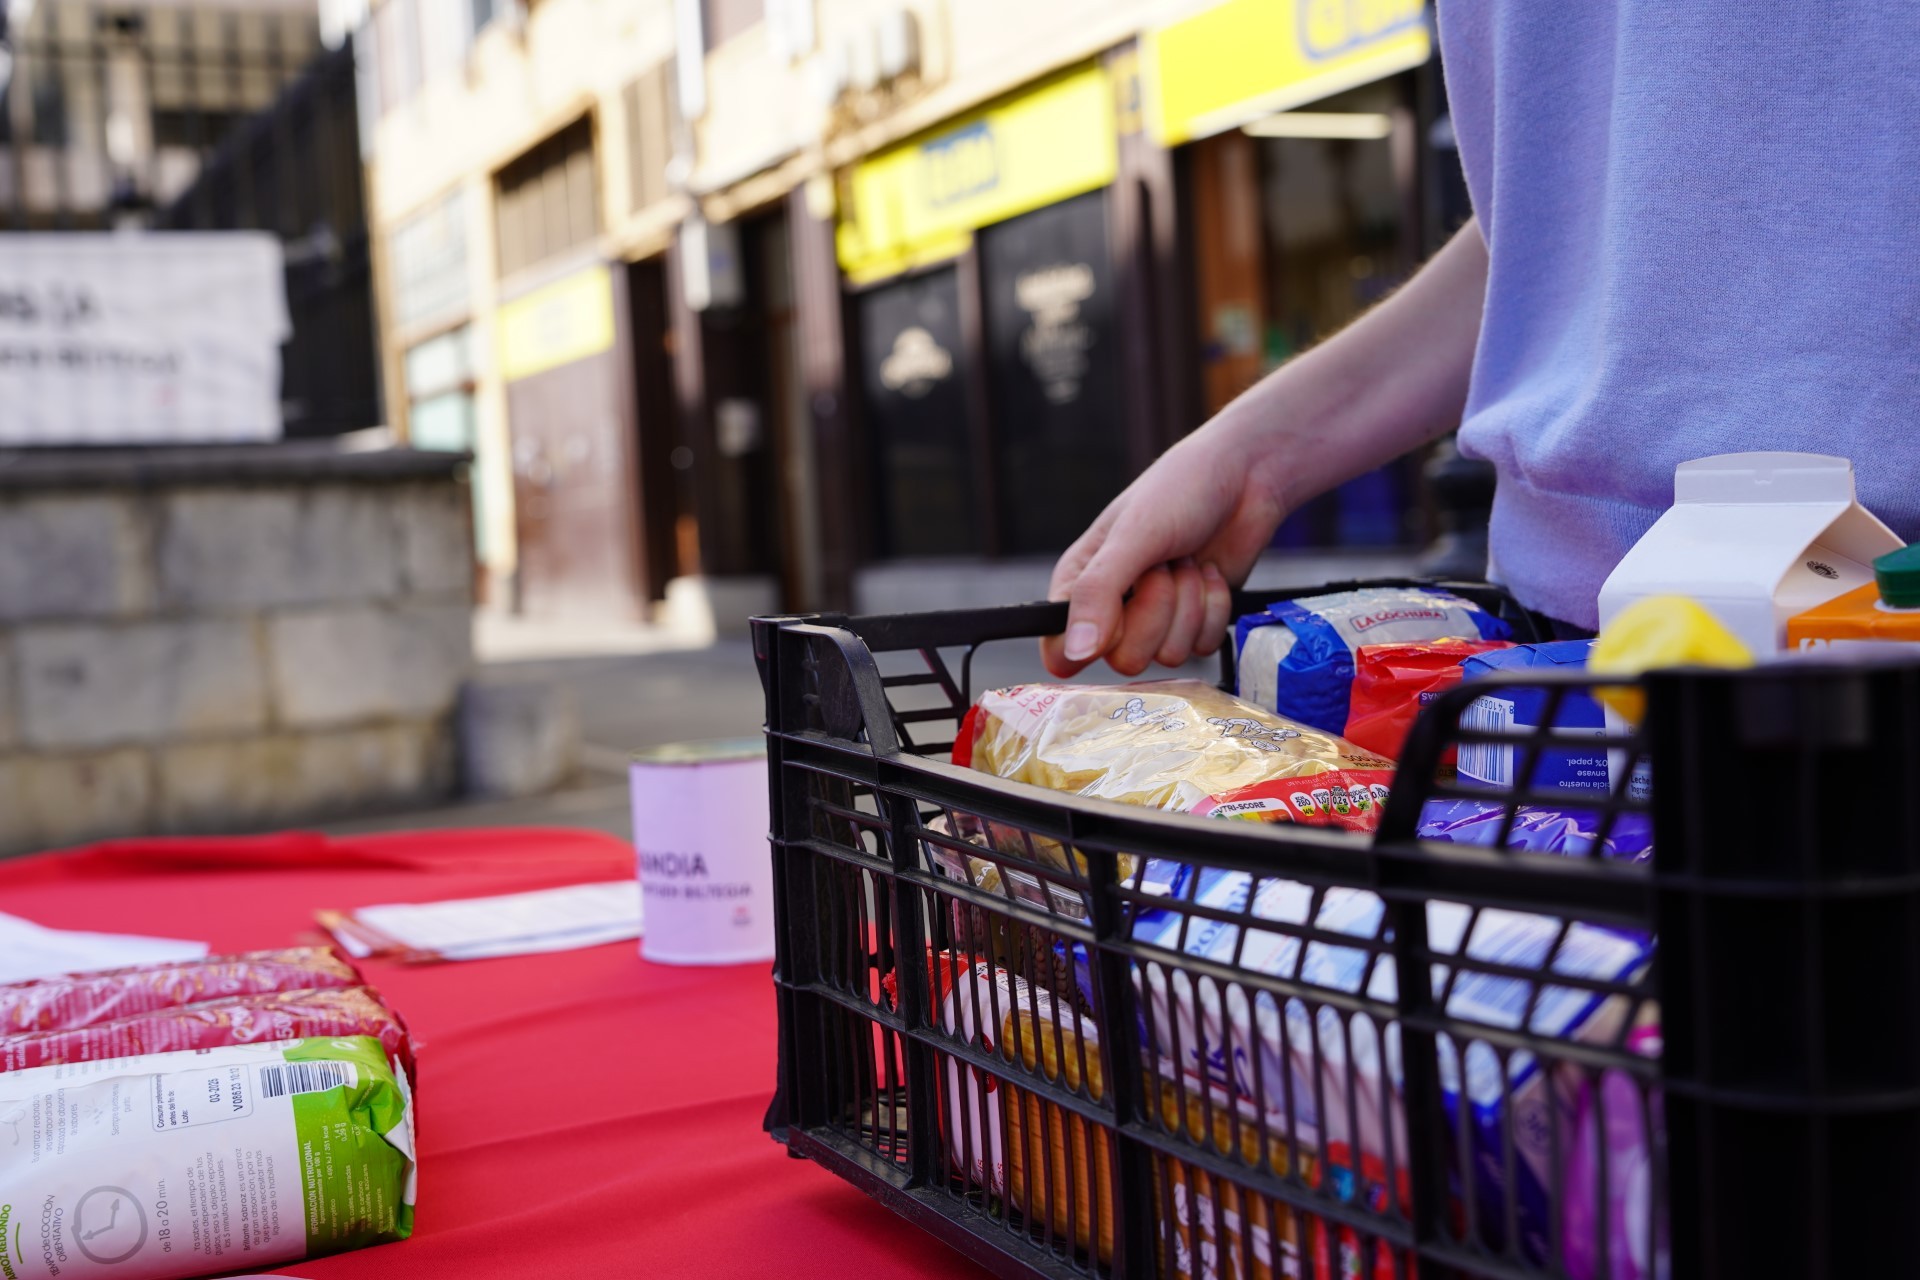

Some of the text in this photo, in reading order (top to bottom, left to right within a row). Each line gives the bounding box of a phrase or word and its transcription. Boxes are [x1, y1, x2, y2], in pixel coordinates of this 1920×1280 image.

[1355, 609, 1443, 630] LA COCHURA
[1566, 757, 1593, 768] papel.
[1559, 780, 1591, 789] nuestro
[1577, 770, 1606, 778] envase
[1210, 801, 1266, 817] NUTRI-SCORE
[1296, 799, 1311, 807] 280
[206, 1152, 217, 1182] reposar
[235, 1148, 243, 1169] arroz
[248, 1163, 257, 1175] por
[187, 1180, 197, 1208] tiempo
[258, 1170, 266, 1204] necesitar
[305, 1141, 318, 1235] INFORMACIÓN NUTRICIONAL
[156, 1201, 168, 1217] 20
[198, 1183, 209, 1226] dependerá
[239, 1193, 248, 1221] Sabroz
[219, 1203, 228, 1231] minutos
[261, 1206, 270, 1229] puede
[159, 1229, 170, 1240] 18
[162, 1242, 171, 1252] de
[0, 1253, 17, 1280] ARROZ
